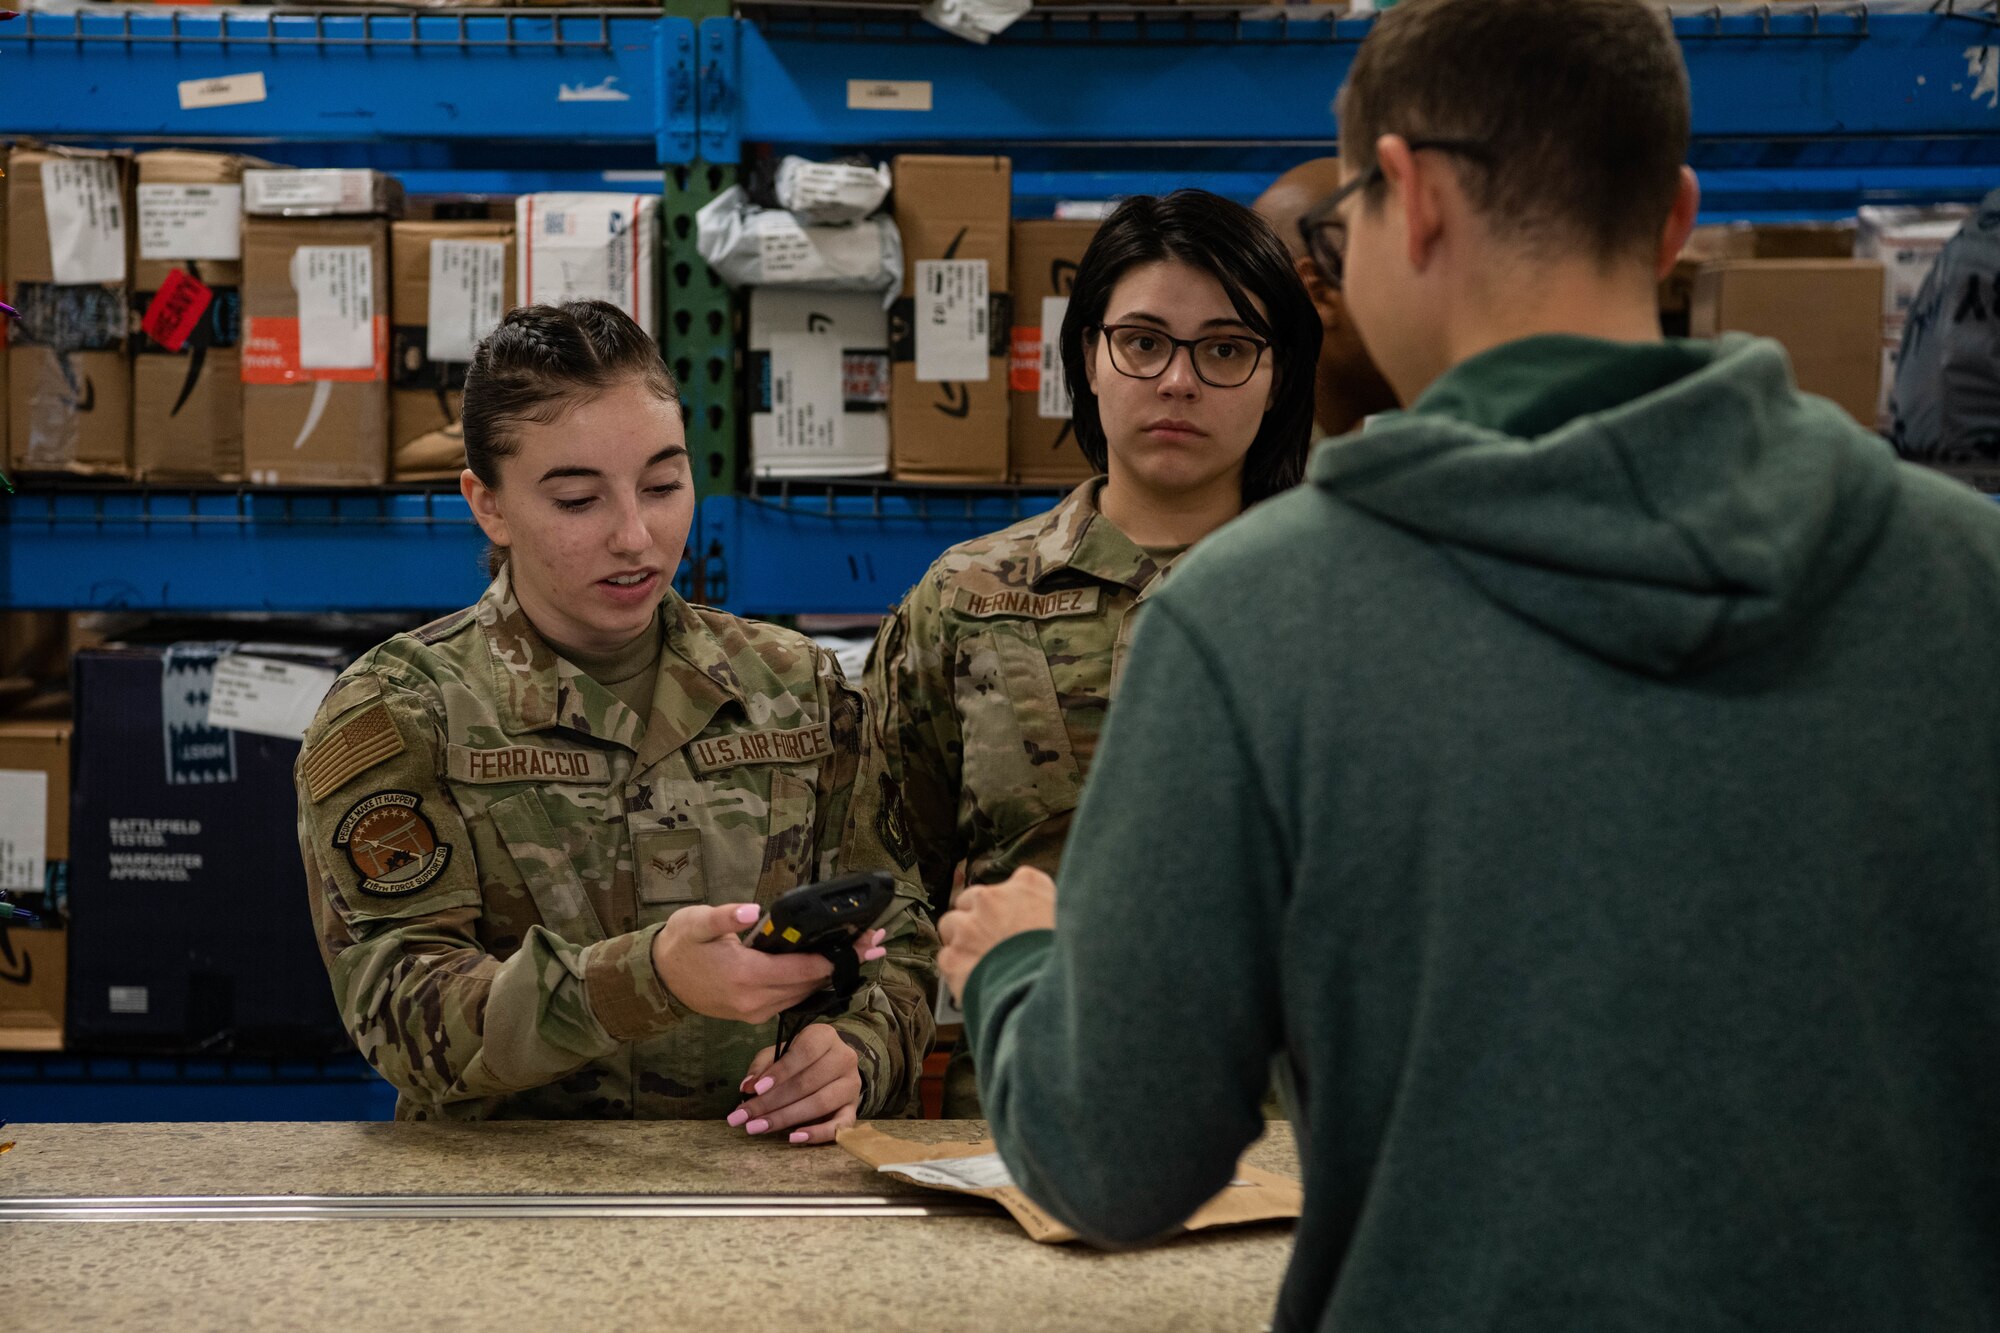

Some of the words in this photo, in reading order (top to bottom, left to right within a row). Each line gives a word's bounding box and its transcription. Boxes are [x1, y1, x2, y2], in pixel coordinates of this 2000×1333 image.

[966, 590, 1084, 616] HERNANDEZ
[740, 733, 772, 760] AIR
[771, 727, 828, 760] FORCE
[469, 748, 590, 779] FERRACCIO
[109, 817, 202, 835] BATTLEFIELD
[339, 815, 357, 841] PEOPLE
[354, 800, 374, 817] MAKE
[375, 797, 382, 805] IT
[384, 795, 414, 806] HAPPEN
[390, 880, 415, 892] FORCE
[416, 860, 443, 885] SUPPORT
